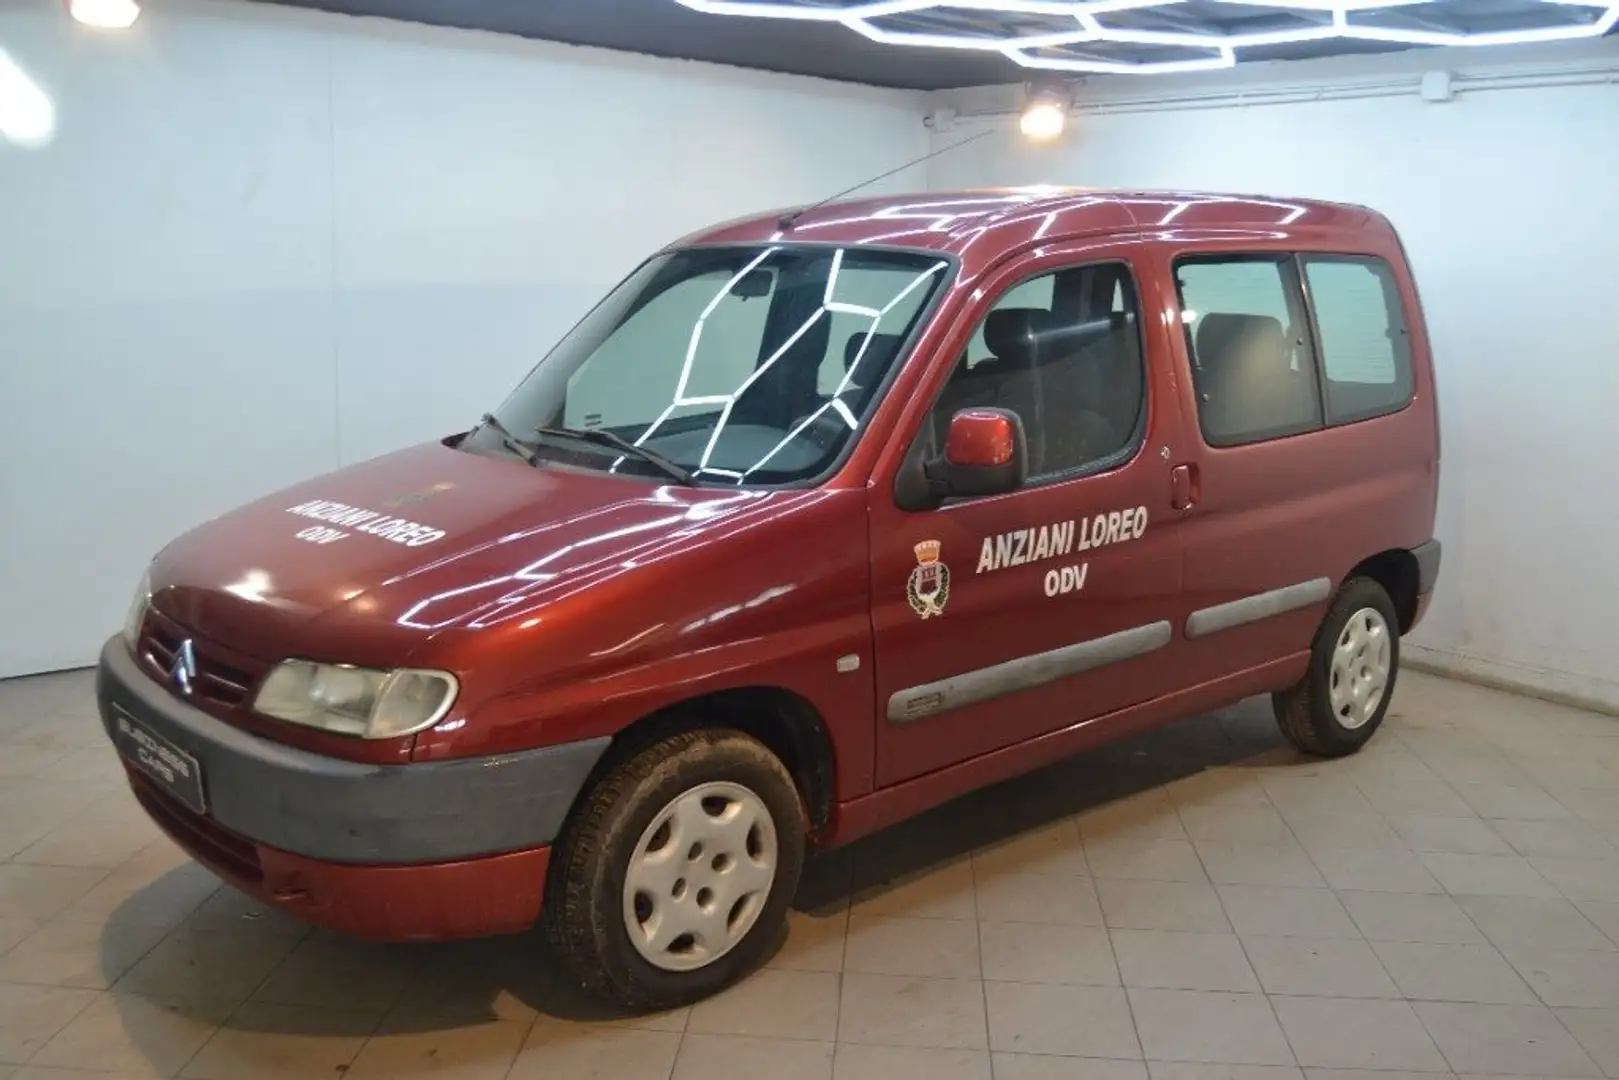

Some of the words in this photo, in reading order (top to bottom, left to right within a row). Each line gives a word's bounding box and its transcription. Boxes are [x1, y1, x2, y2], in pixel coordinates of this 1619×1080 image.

[285, 499, 379, 527] ANZIANI
[355, 515, 446, 547] LOREO
[295, 525, 352, 544] ODV
[975, 519, 1075, 574] ANZIANI
[1078, 505, 1148, 551] LOREO
[1043, 562, 1089, 598] ODV
